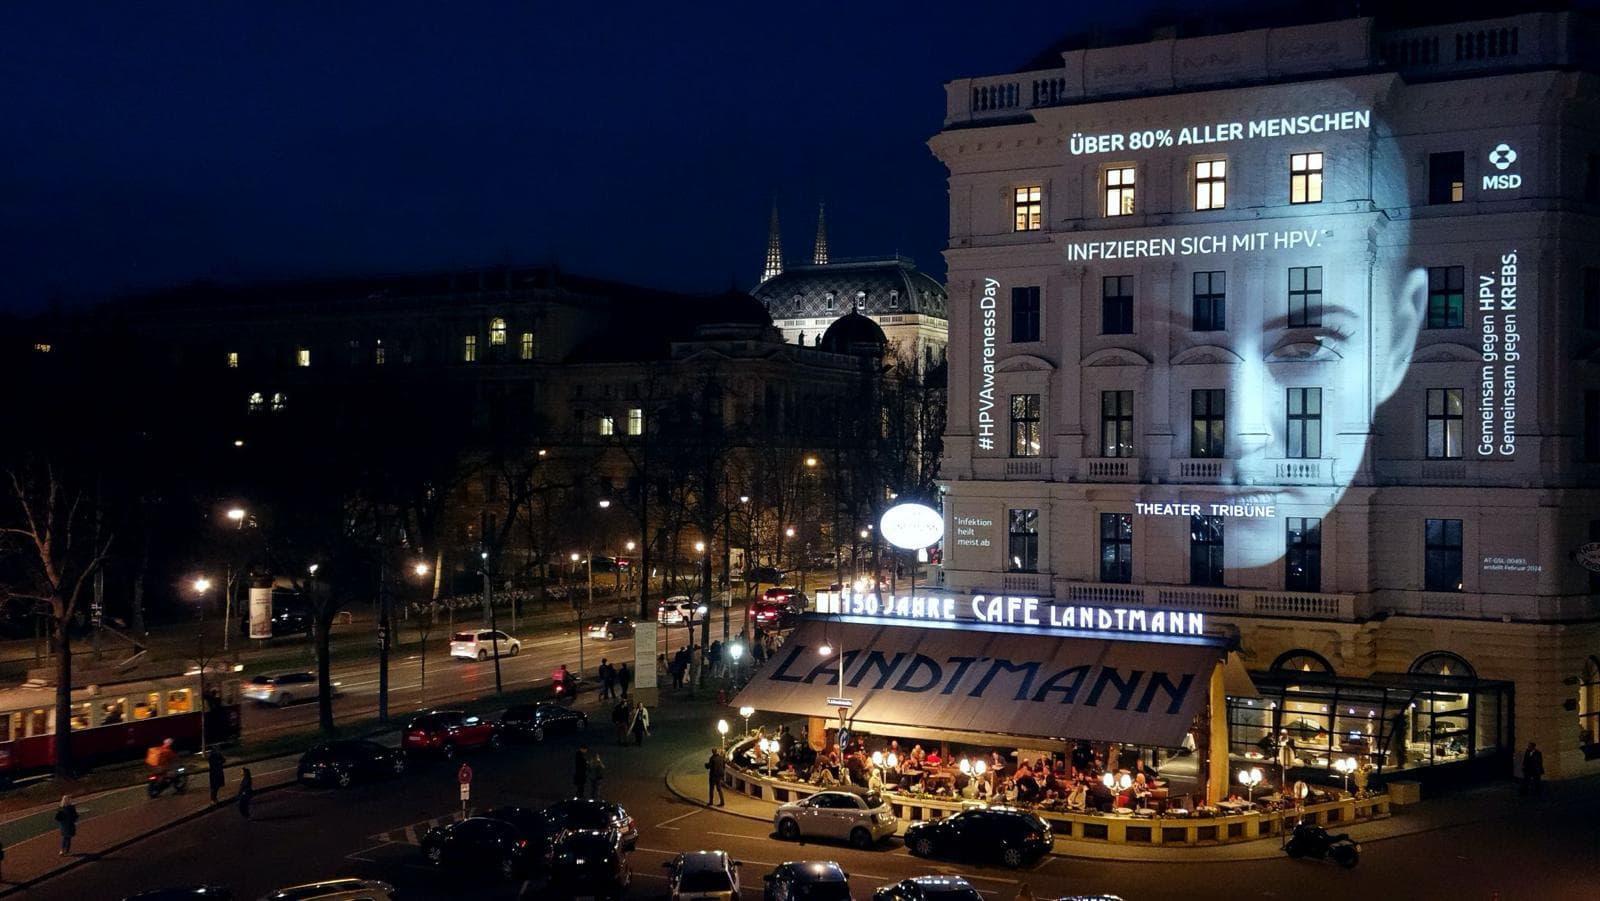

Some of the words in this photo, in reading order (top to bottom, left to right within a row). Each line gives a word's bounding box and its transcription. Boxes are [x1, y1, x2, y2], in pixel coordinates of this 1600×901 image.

[1070, 133, 1125, 155] ÜBER
[1129, 129, 1173, 150] 80%
[1177, 122, 1244, 146] ALLER
[1248, 110, 1371, 139] MENSCHEN
[1482, 174, 1522, 190] MSD
[1067, 237, 1176, 261] INFIZIEREN
[1180, 234, 1227, 255] SICH
[1232, 231, 1269, 252] MIT
[1479, 271, 1496, 311] HPV.
[1501, 249, 1518, 311] KREBS.
[1482, 314, 1499, 362] gegen
[1504, 314, 1520, 362] gegen
[978, 277, 1001, 451] #HPVAwarenessDay
[1478, 365, 1495, 456] Gemeinsam
[1499, 364, 1516, 456] Gemeinsam
[957, 527, 975, 536] heilt
[1135, 502, 1201, 516] THEATER
[1209, 502, 1276, 518] TRIBÜNE
[957, 537, 980, 546] meist
[980, 538, 991, 547] ab
[882, 595, 956, 619] JAHRE
[971, 594, 1040, 625] CAFE
[1050, 605, 1204, 634] LANDTMANN
[768, 645, 1196, 714] LANDTMANN
